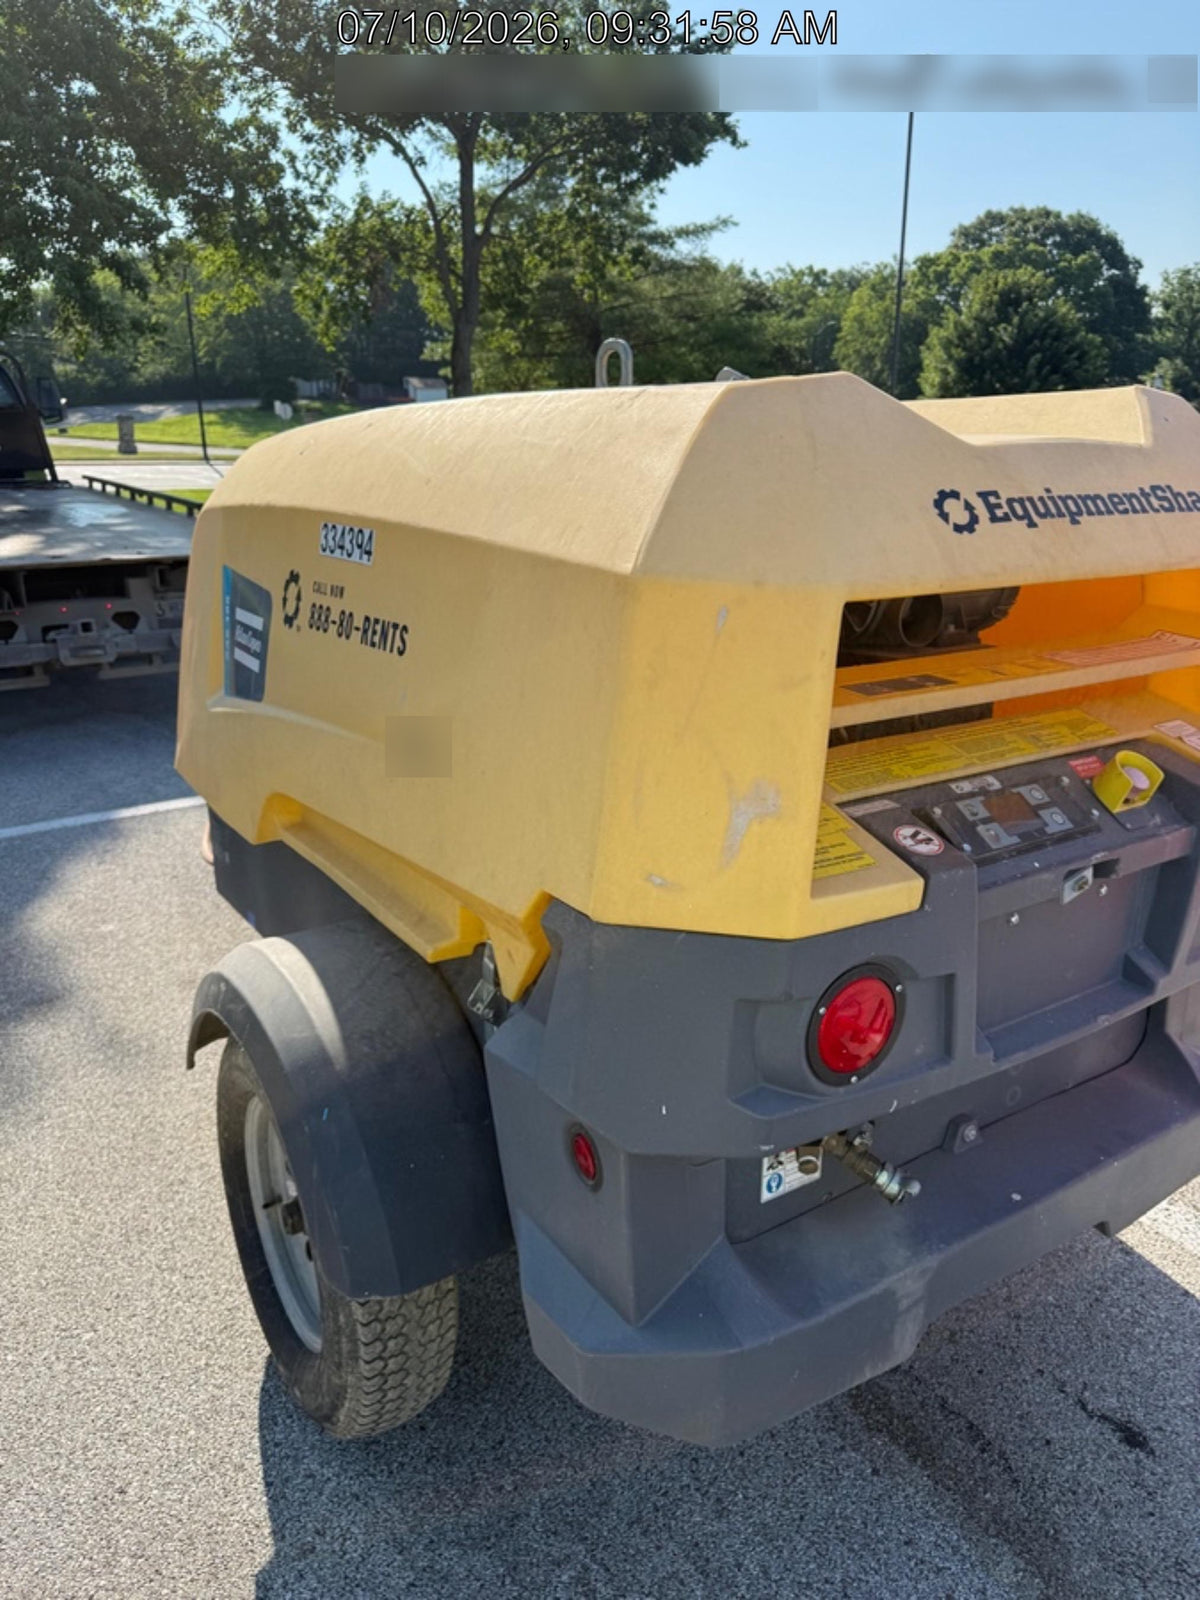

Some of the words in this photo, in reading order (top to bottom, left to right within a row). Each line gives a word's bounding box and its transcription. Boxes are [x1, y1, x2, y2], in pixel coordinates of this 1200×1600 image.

[976, 484, 1200, 528] EquipmentSha
[321, 522, 374, 562] 334394
[308, 602, 409, 657] 888-80-RENTS
